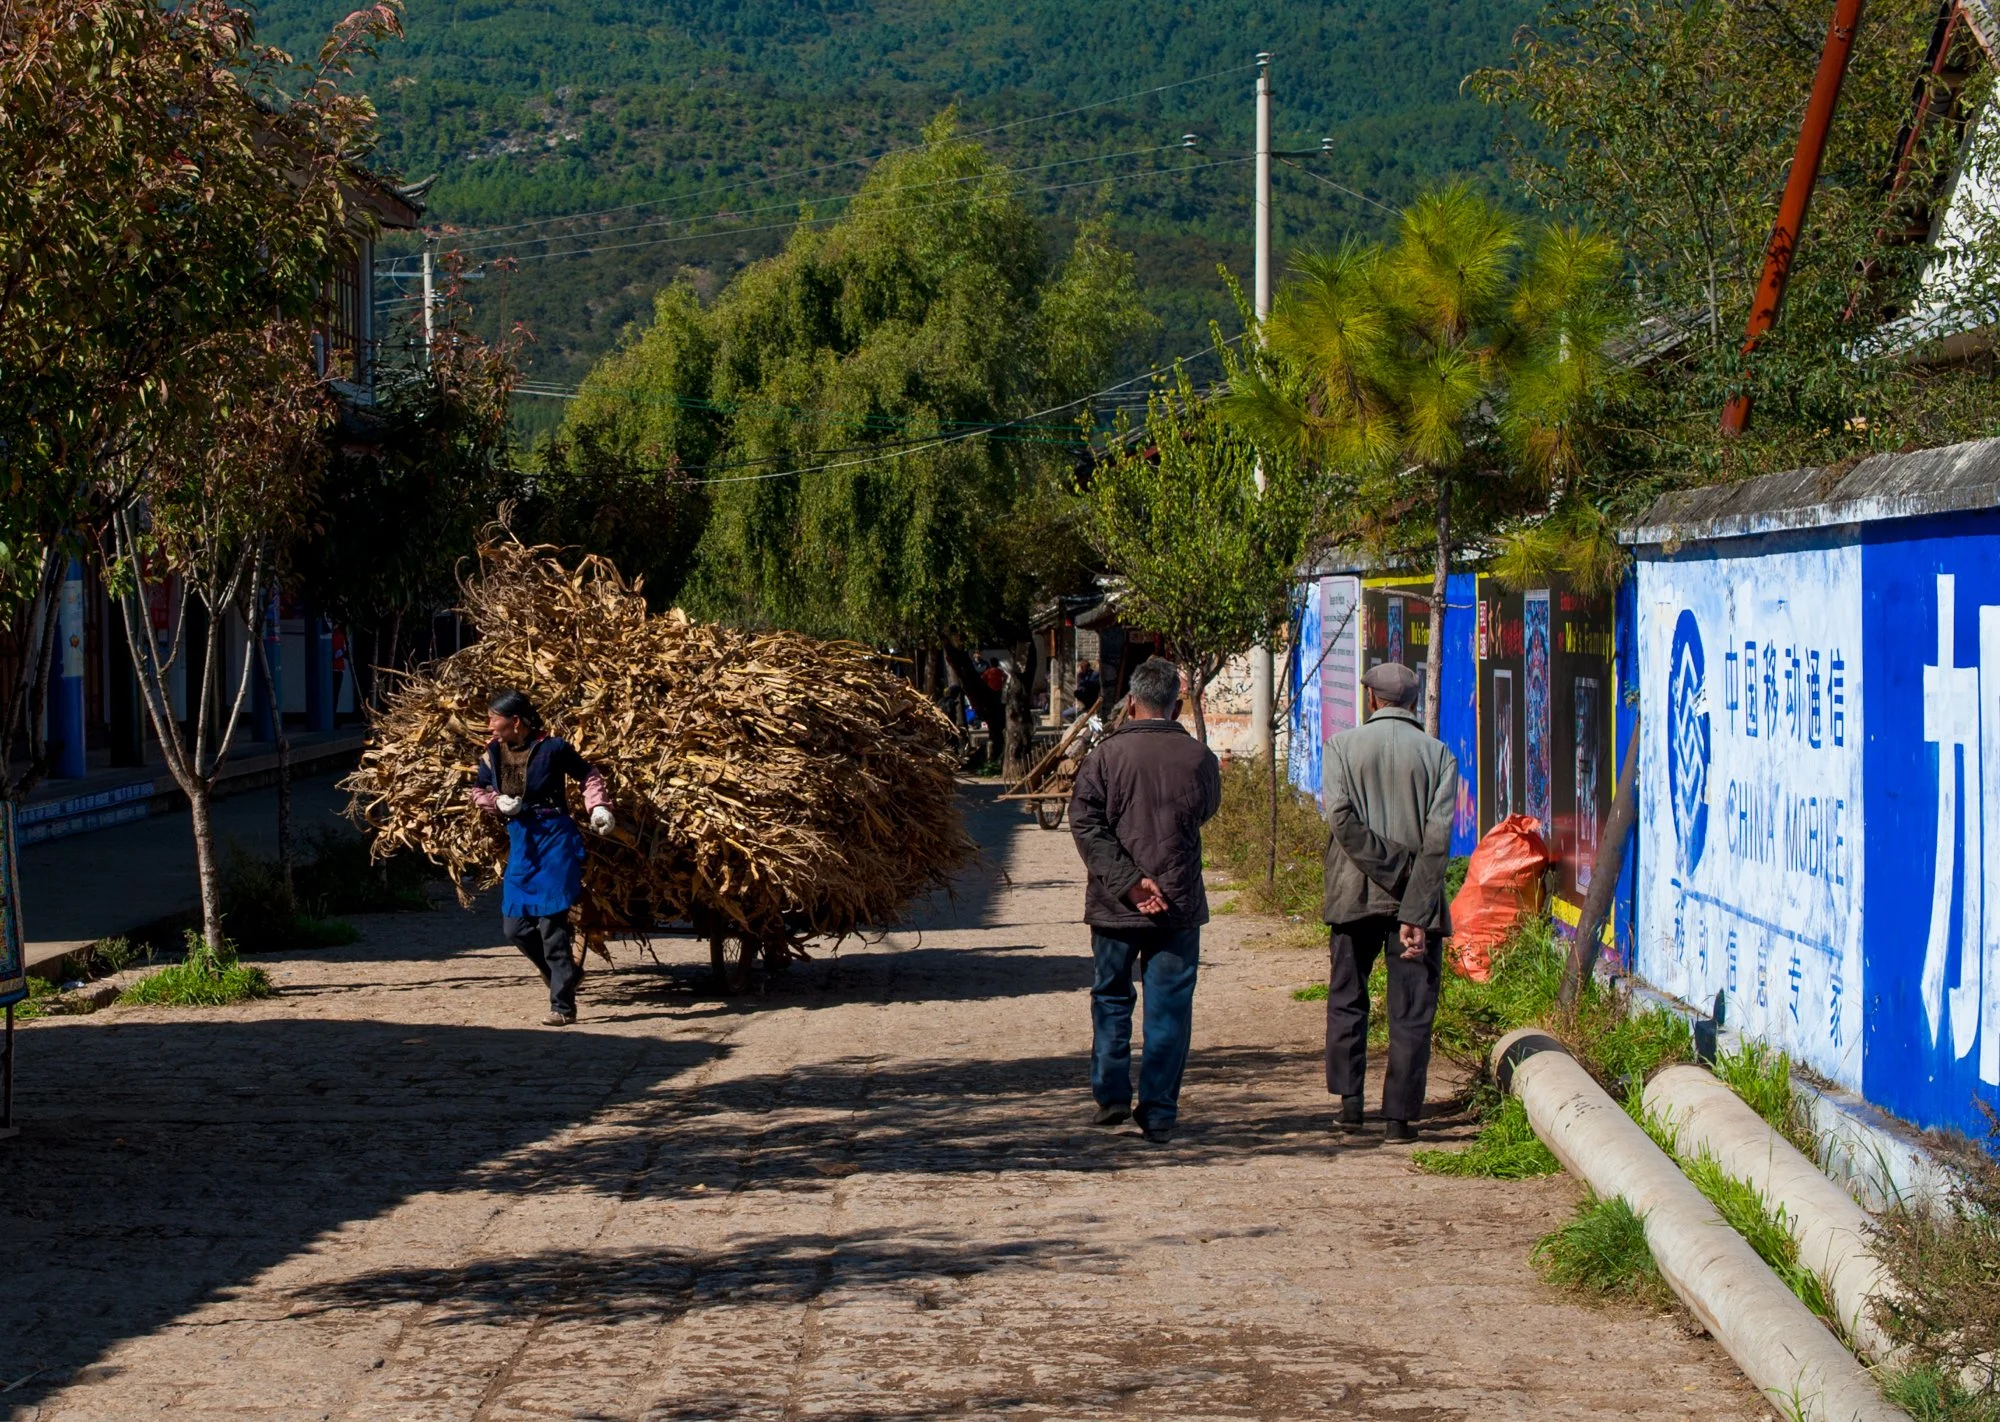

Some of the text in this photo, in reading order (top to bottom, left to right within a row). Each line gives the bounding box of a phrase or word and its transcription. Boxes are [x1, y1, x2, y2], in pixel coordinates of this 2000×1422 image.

[1584, 622, 1610, 664] Family
[1725, 633, 1845, 749] 中国移动通信
[1727, 778, 1845, 887] CHINA MOBILE
